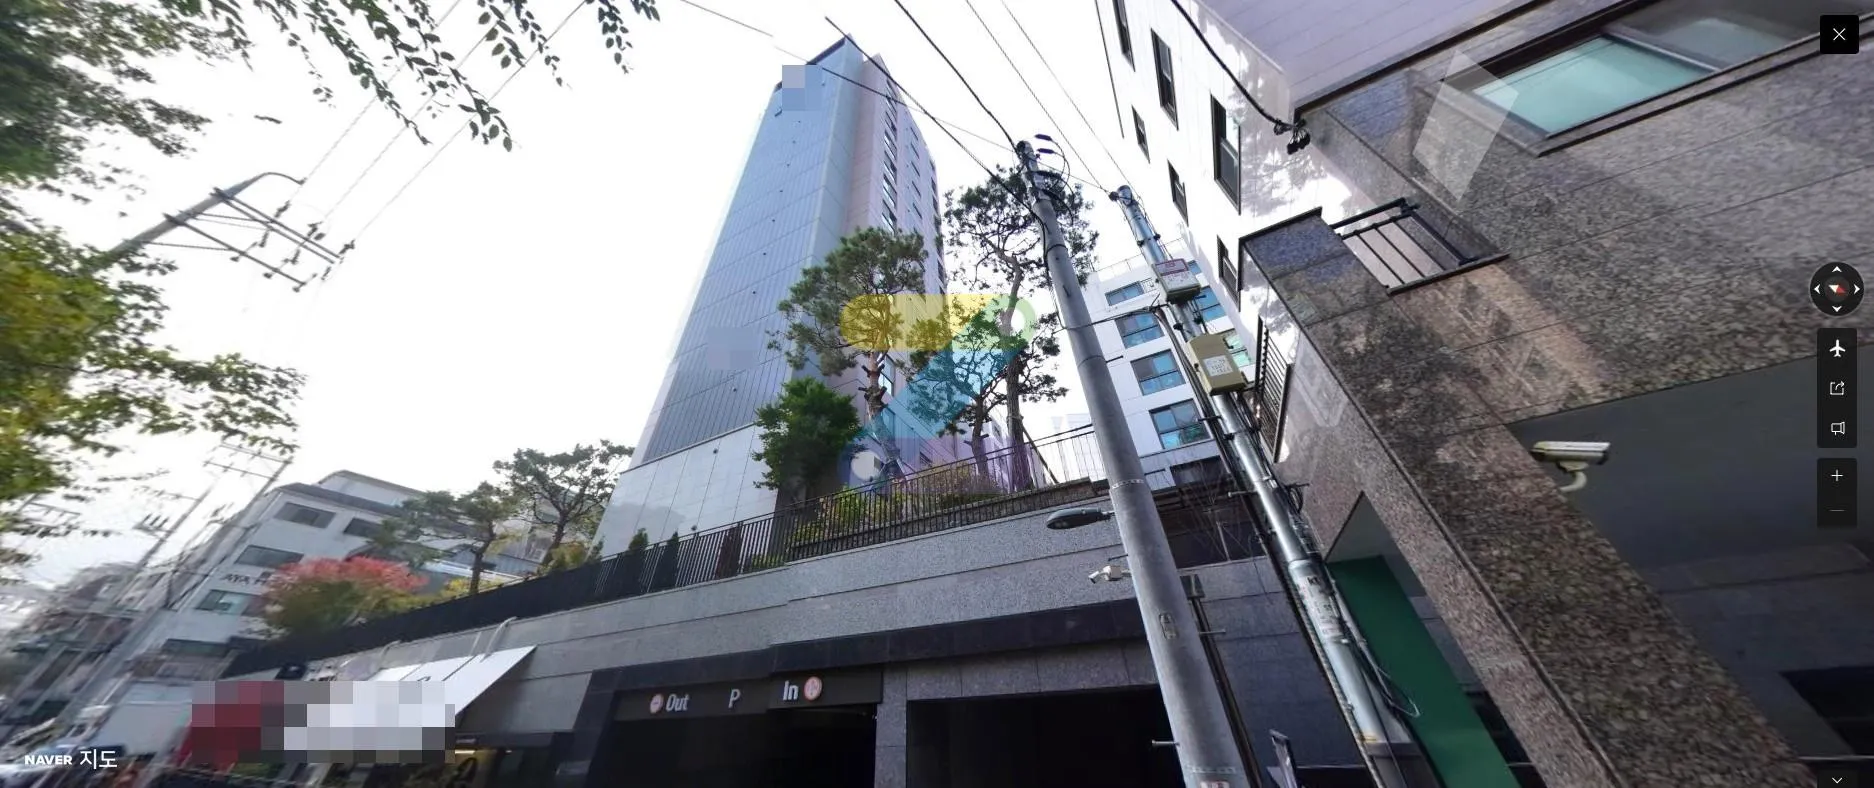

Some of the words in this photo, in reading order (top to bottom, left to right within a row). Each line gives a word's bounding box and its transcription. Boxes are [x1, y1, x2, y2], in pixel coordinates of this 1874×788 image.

[665, 693, 690, 712] Out
[728, 688, 741, 709] P
[782, 680, 799, 701] In
